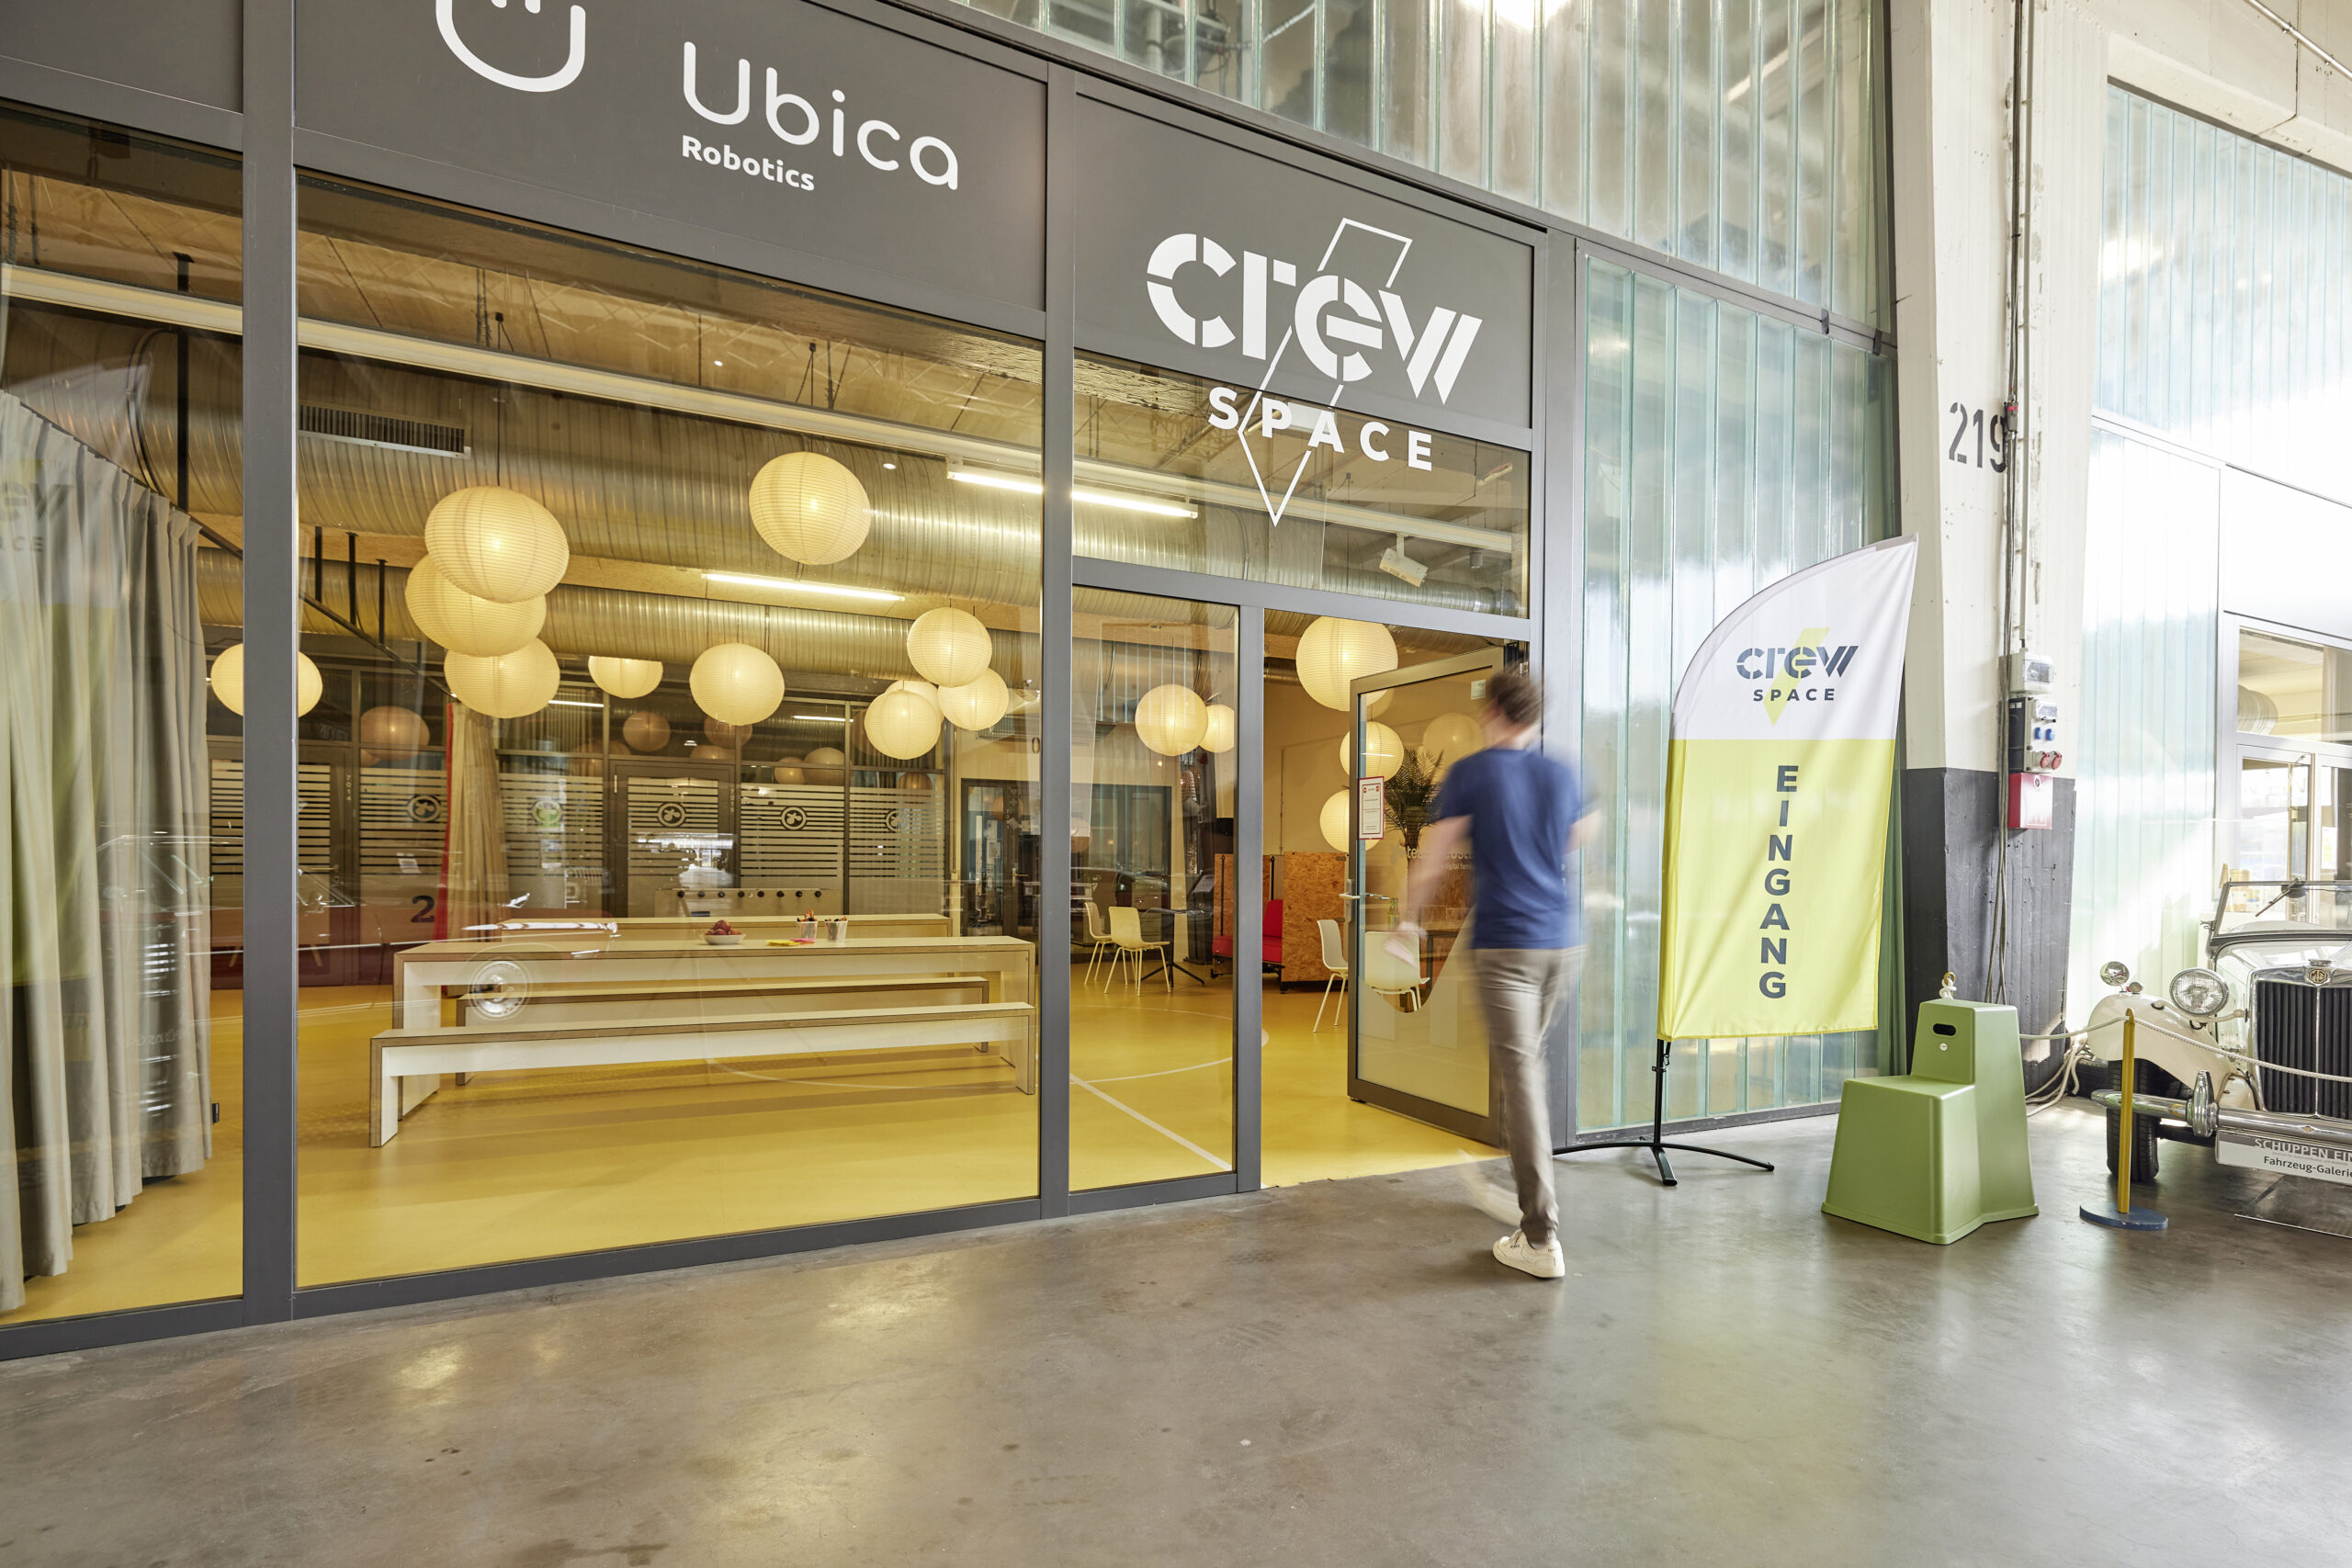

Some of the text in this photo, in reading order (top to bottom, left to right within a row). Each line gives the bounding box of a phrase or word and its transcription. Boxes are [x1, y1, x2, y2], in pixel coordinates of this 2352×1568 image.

[684, 41, 958, 190] Ubica
[682, 135, 815, 191] Robotics
[1147, 233, 1483, 405] crew
[1208, 386, 1432, 471] SPACE
[1949, 401, 2007, 473] 219
[1736, 646, 1859, 680] crew
[1753, 689, 1835, 701] SPACE
[1758, 765, 1799, 999] EINGANG
[2311, 970, 2325, 982] MG
[2255, 1139, 2328, 1158] SCHUPPEN
